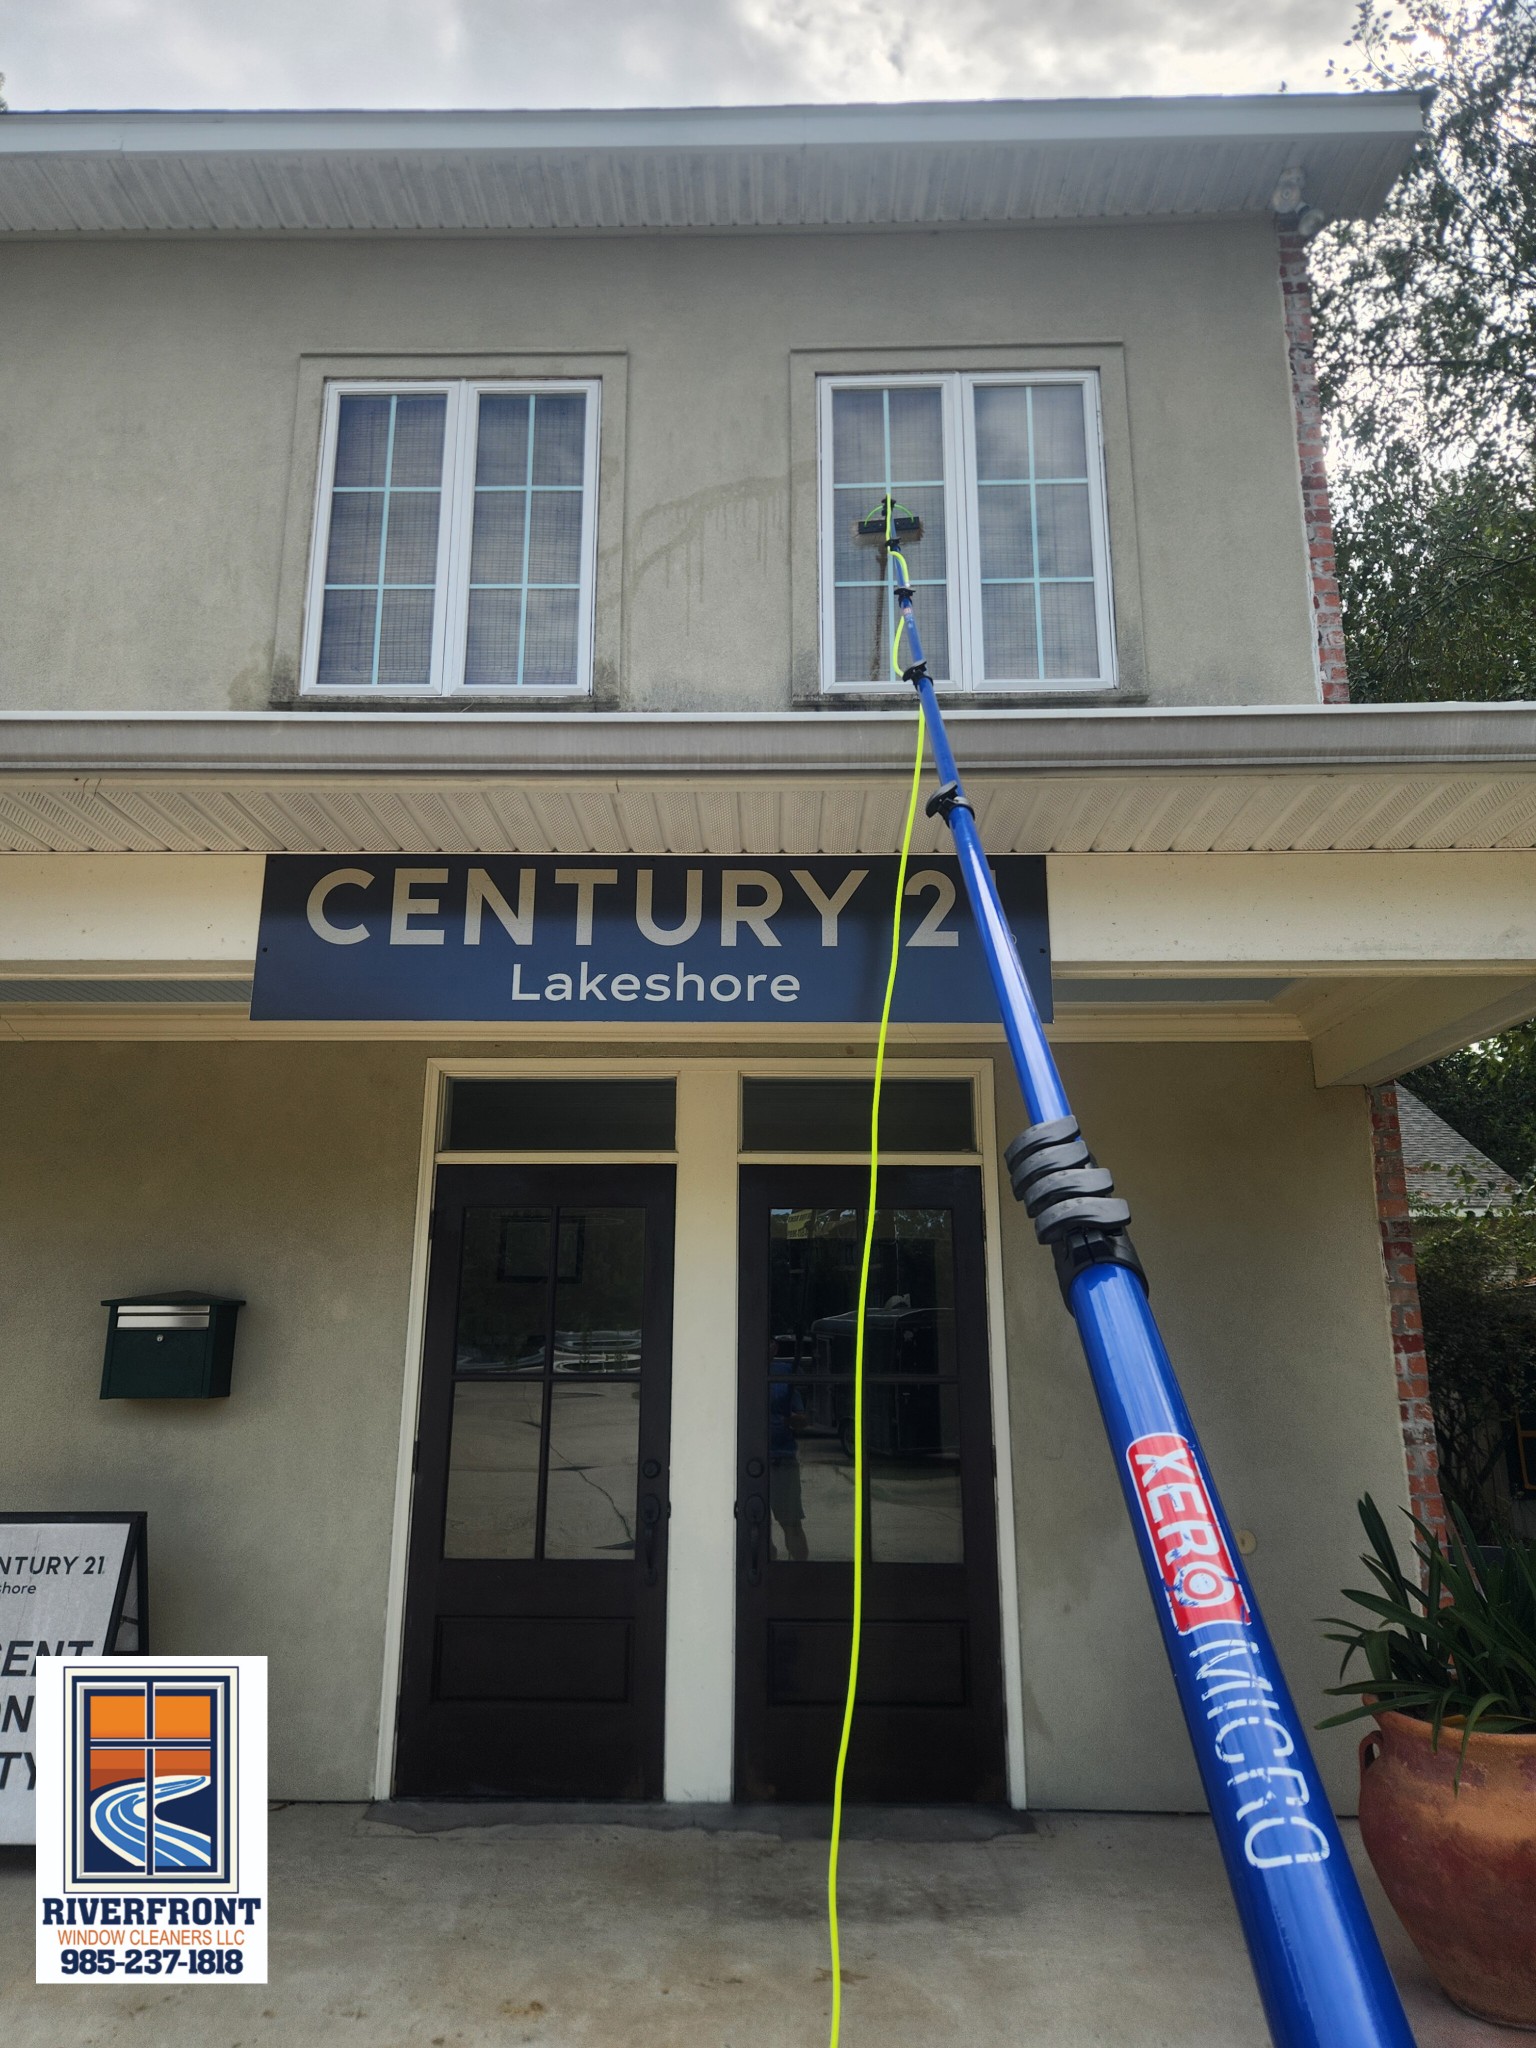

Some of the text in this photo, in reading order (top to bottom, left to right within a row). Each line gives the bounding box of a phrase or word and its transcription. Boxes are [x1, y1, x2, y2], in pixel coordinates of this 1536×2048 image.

[307, 868, 996, 947] CENTURY 2
[511, 962, 801, 1003] Lakeshore
[83, 1556, 105, 1575] 21
[1135, 1449, 1331, 1870] XERO MICRO
